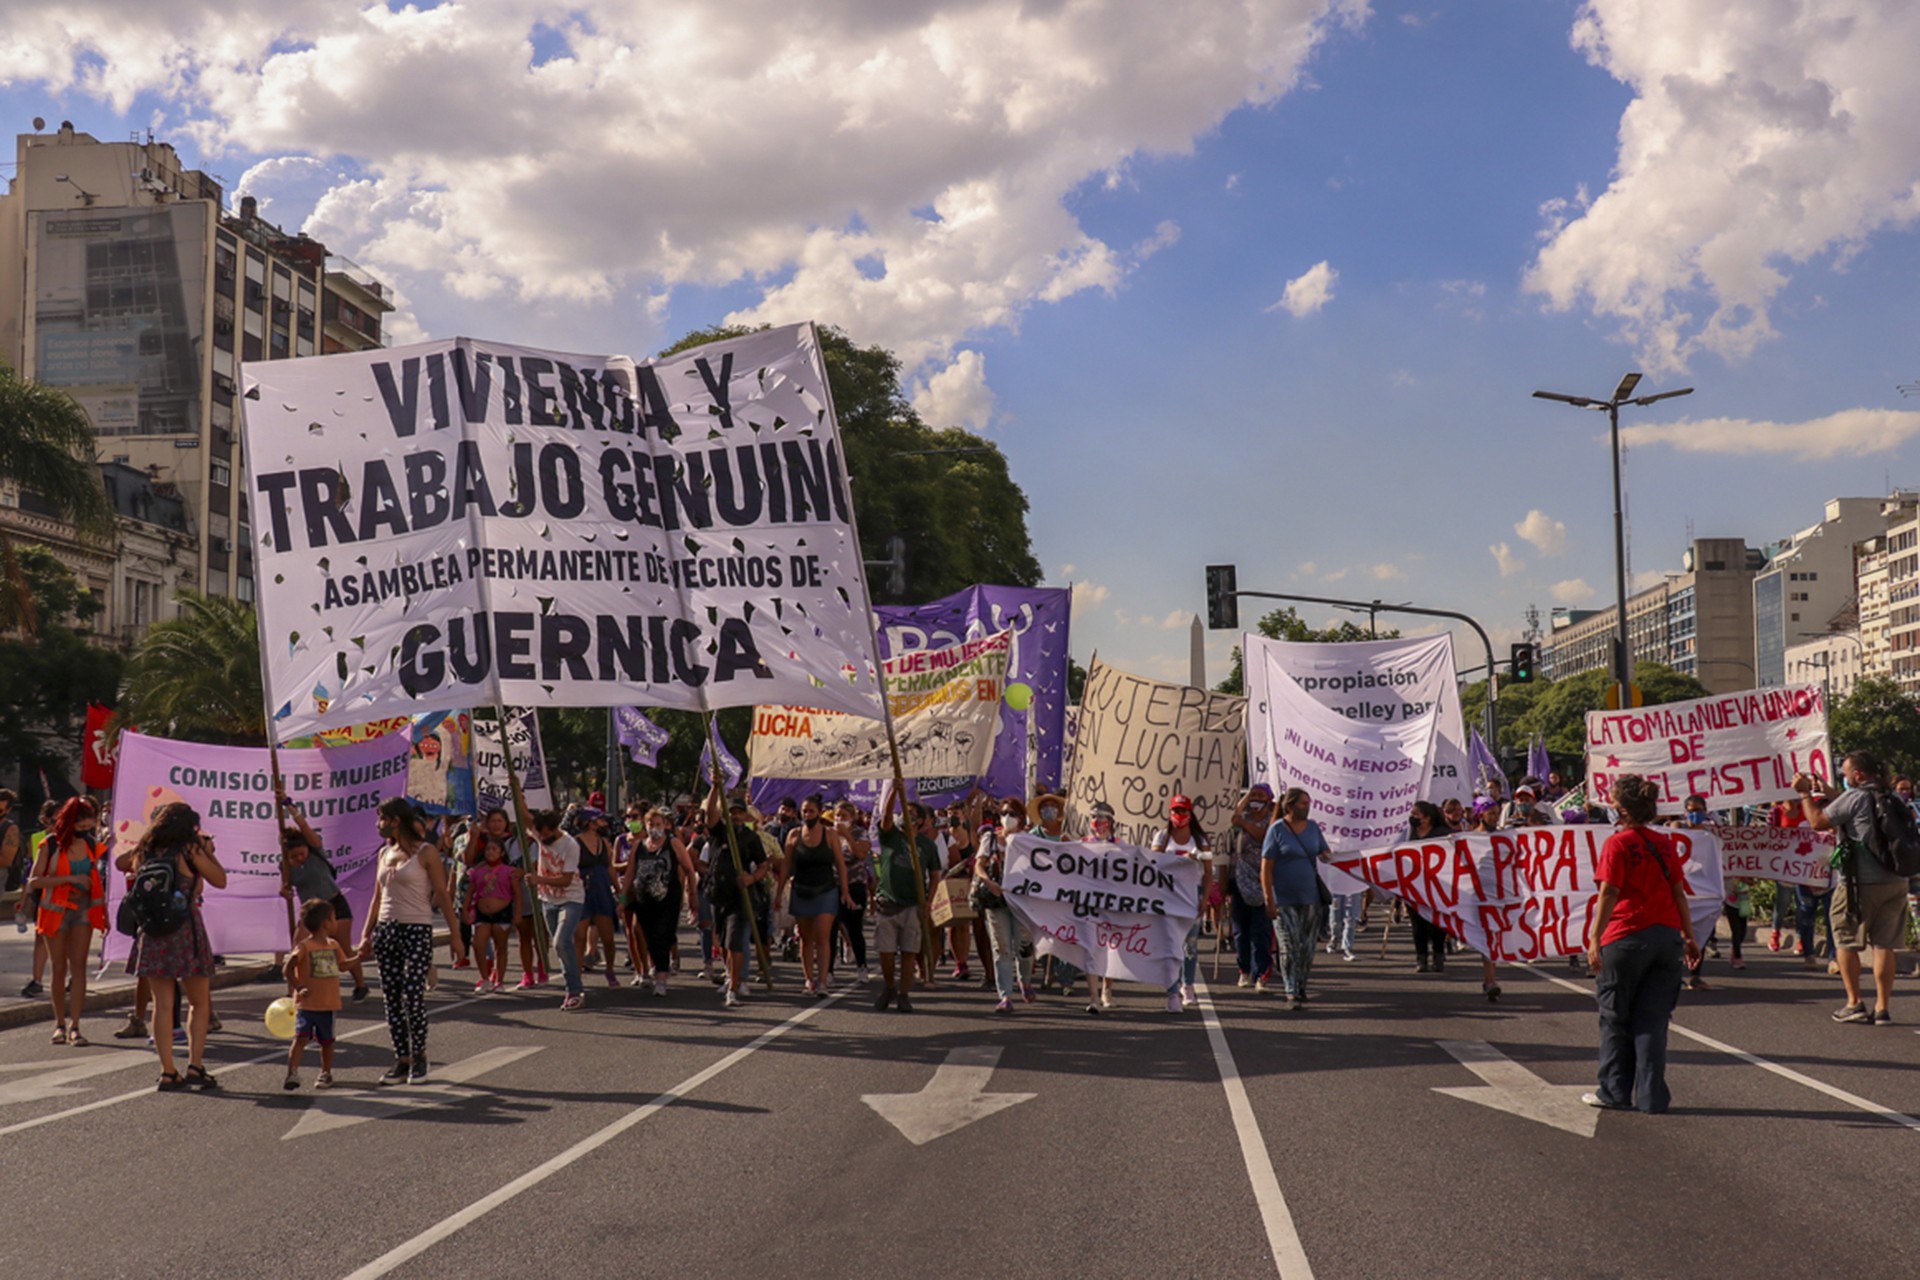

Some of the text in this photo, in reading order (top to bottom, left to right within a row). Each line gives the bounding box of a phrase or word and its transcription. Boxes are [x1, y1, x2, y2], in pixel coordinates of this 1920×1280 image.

[371, 348, 734, 441] VIVIENDA Y
[257, 440, 584, 553] TRABAJO
[324, 552, 462, 609] ASAMBLEA
[467, 547, 641, 582] PERMANENTE
[645, 552, 669, 585] DE
[790, 555, 822, 587] DE
[399, 612, 771, 693] GUERNICA
[900, 654, 925, 672] DE
[977, 679, 996, 701] EN
[1289, 668, 1418, 693] xpropiación
[753, 713, 813, 739] UCHA
[1114, 724, 1225, 782] LUCHA
[1303, 740, 1337, 766] UNA
[1342, 757, 1413, 775] MENOS!
[1669, 734, 1705, 764] DE
[294, 773, 323, 791] DE
[330, 751, 409, 788] MUJERES
[1289, 765, 1342, 796] menos
[1346, 787, 1374, 801] sin
[1350, 806, 1377, 819] sin
[1383, 801, 1413, 818] trab
[1491, 829, 1580, 900] PARA
